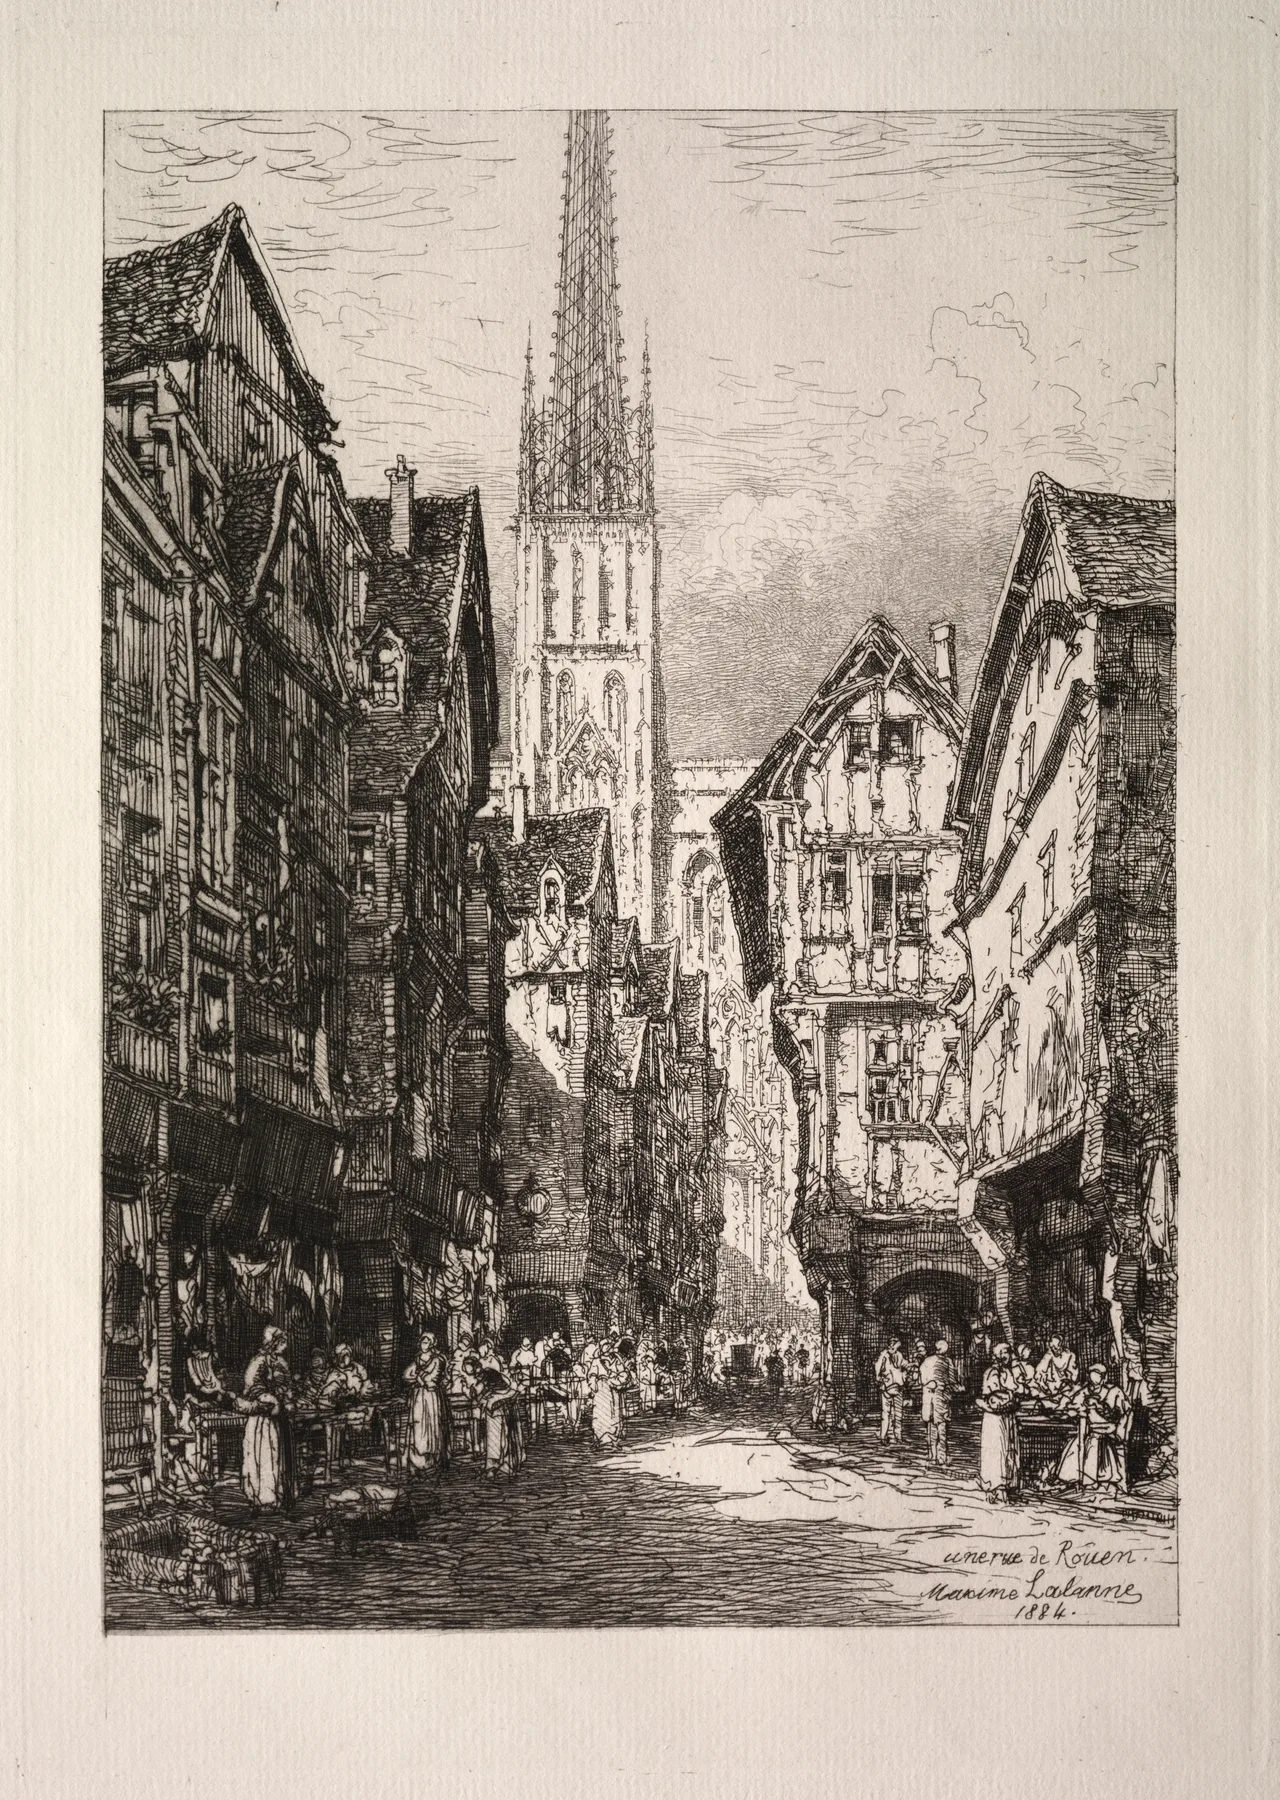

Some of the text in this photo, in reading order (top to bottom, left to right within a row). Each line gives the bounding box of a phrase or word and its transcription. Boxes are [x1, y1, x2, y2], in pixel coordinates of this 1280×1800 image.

[1029, 1545, 1050, 1565] de
[920, 1569, 1142, 1604] Maxime Lalanne
